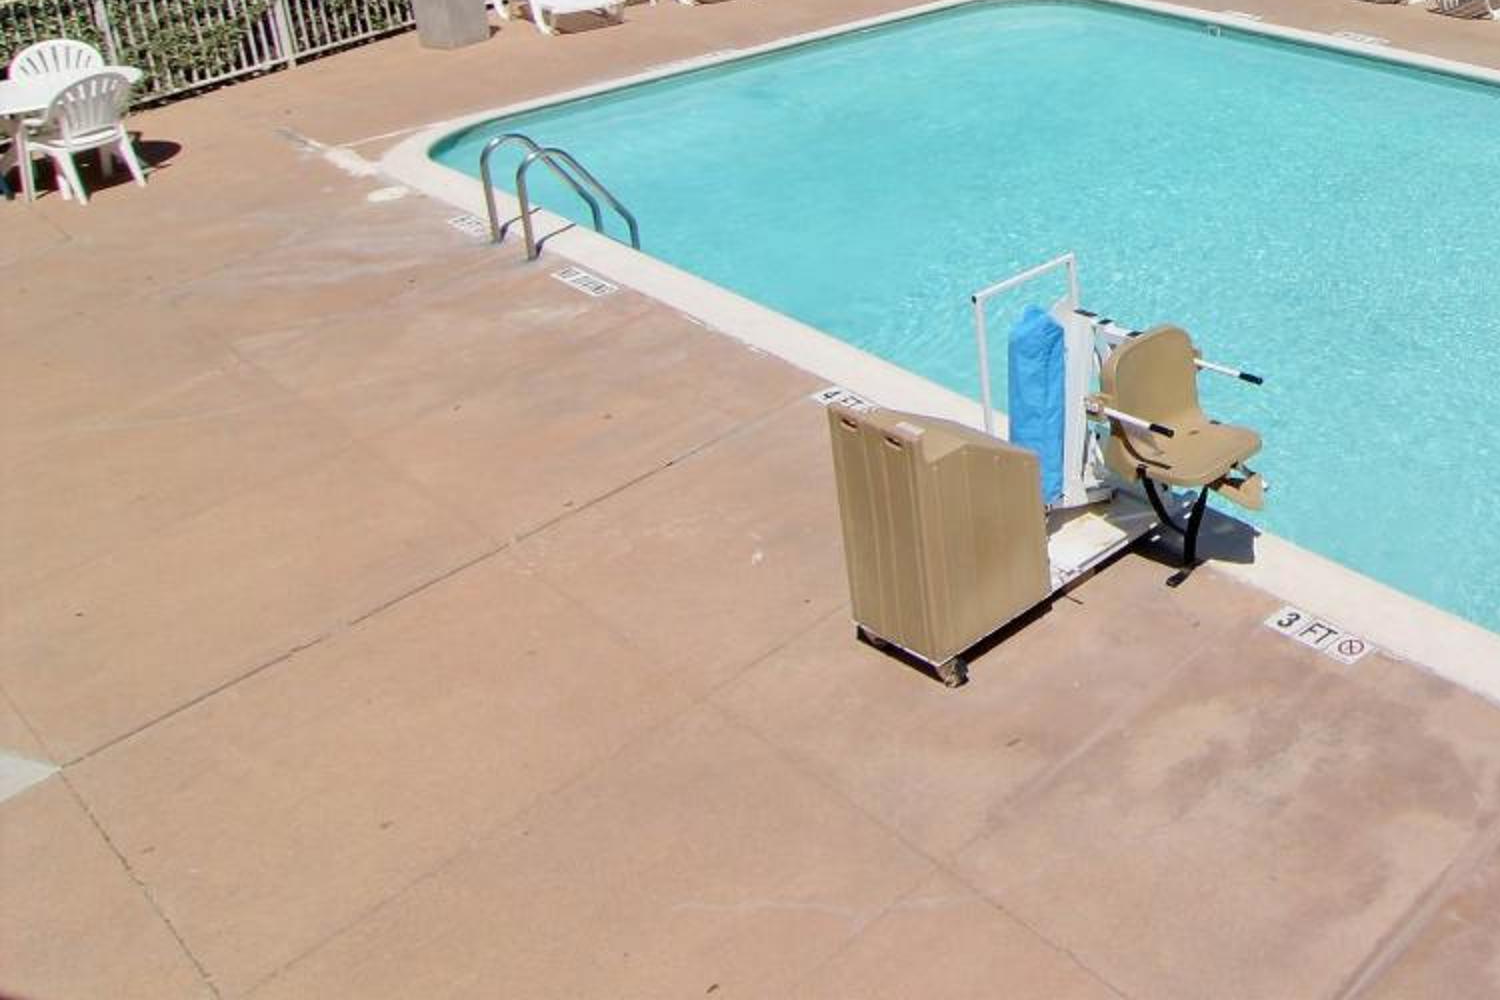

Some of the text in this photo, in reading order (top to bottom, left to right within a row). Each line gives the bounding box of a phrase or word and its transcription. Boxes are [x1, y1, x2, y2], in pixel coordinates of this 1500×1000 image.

[821, 390, 843, 401] 4
[1276, 611, 1339, 645] 3 FT
